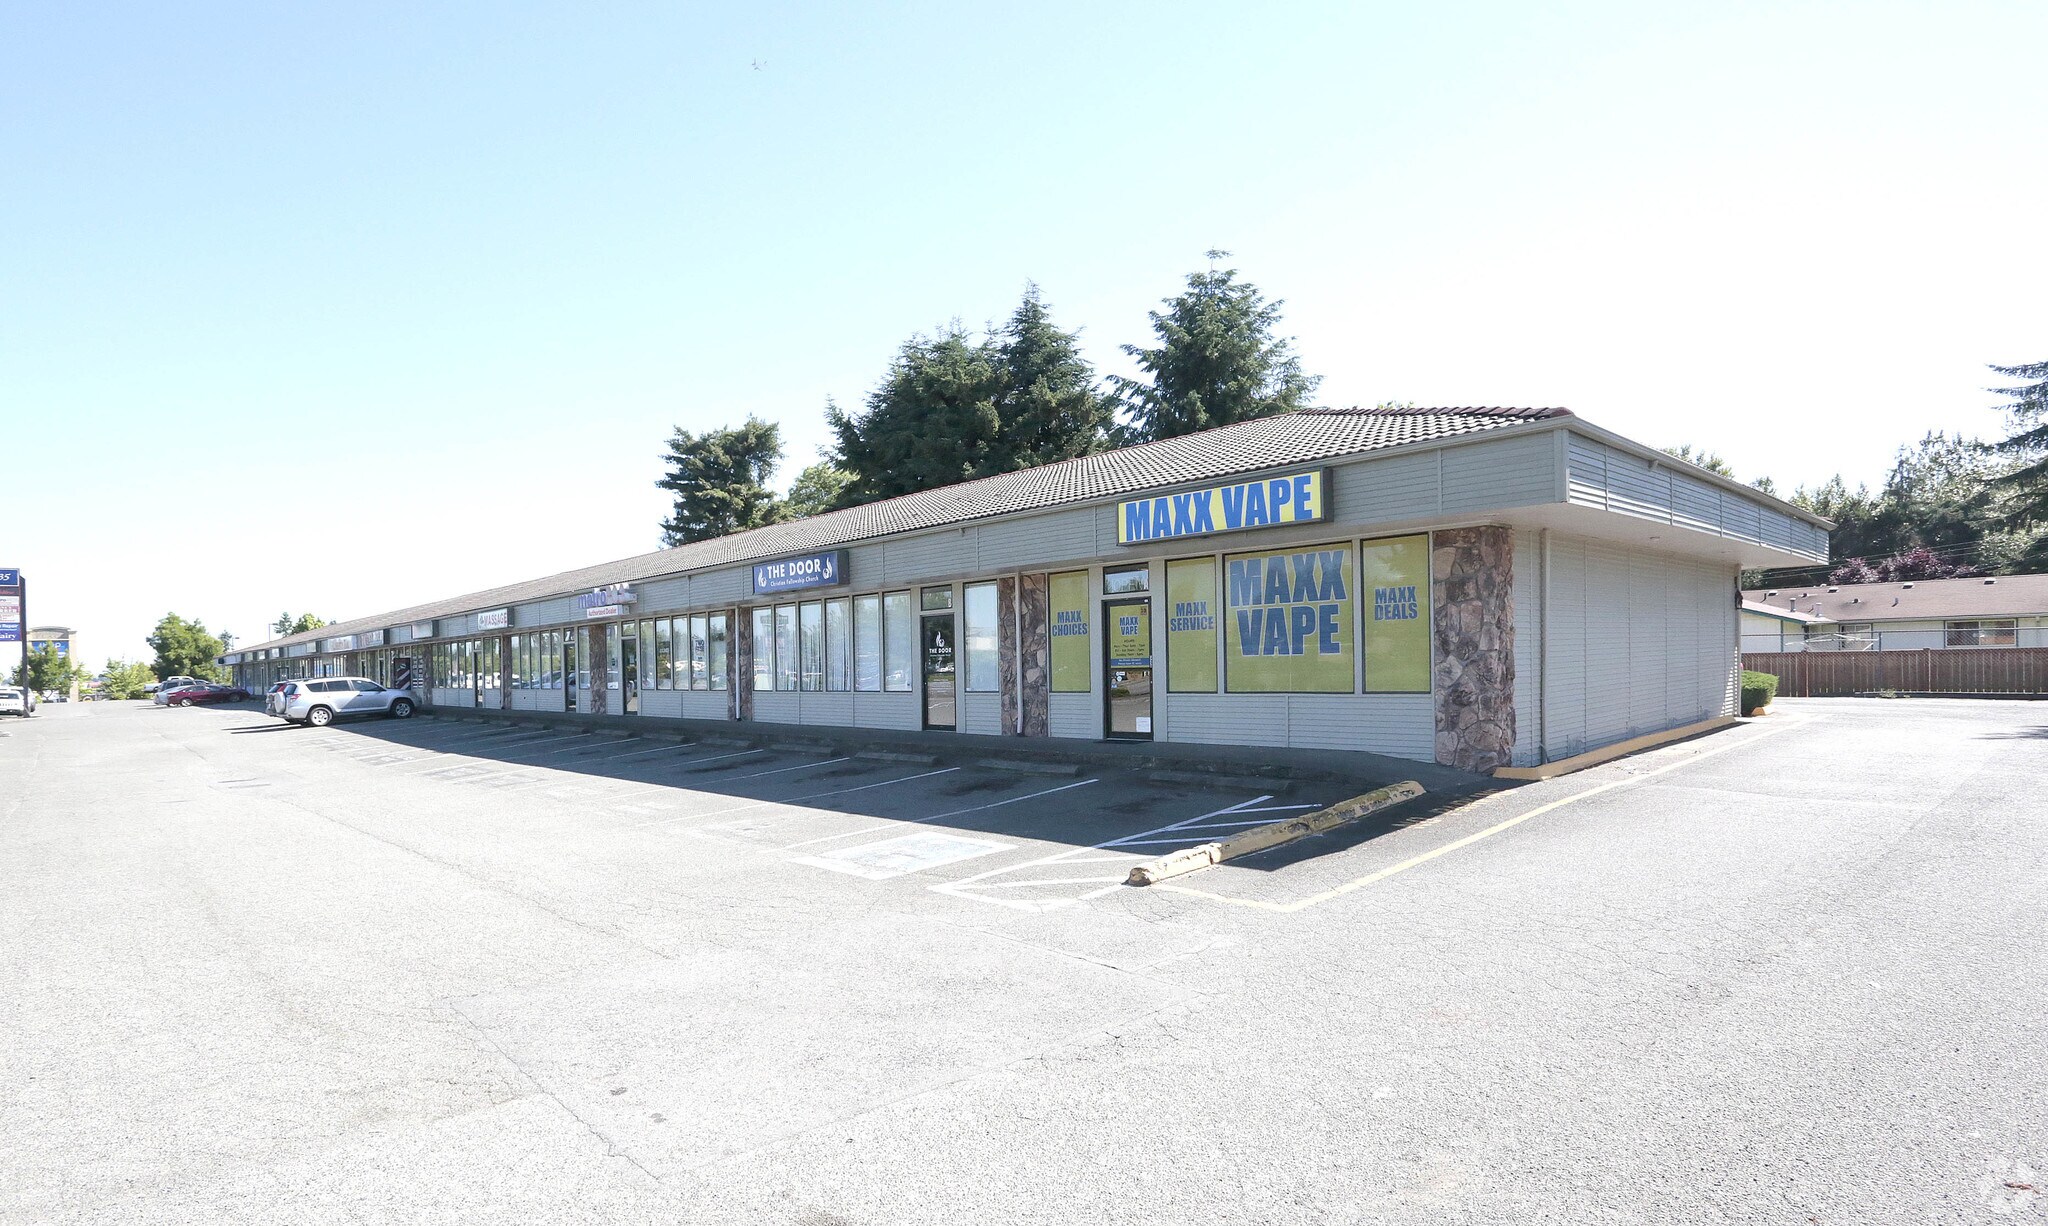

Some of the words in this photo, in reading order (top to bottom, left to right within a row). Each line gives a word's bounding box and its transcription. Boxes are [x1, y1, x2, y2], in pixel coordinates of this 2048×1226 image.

[1125, 490, 1215, 542] MAXX
[1220, 474, 1313, 531] VAPE
[767, 563, 786, 579] THE
[789, 558, 821, 576] DOOR
[1229, 550, 1348, 607] MAXX
[1374, 585, 1417, 604] MAXX
[1057, 610, 1082, 624] MAXX
[1175, 601, 1208, 617] MAXX
[1374, 602, 1418, 621] DEALS
[484, 612, 507, 625] MASSAGE
[1119, 616, 1139, 626] MAXX
[1170, 616, 1214, 632] SERVICE
[1052, 622, 1088, 637] CHOICES
[1120, 625, 1138, 636] VAPE
[1236, 603, 1342, 657] VAPE
